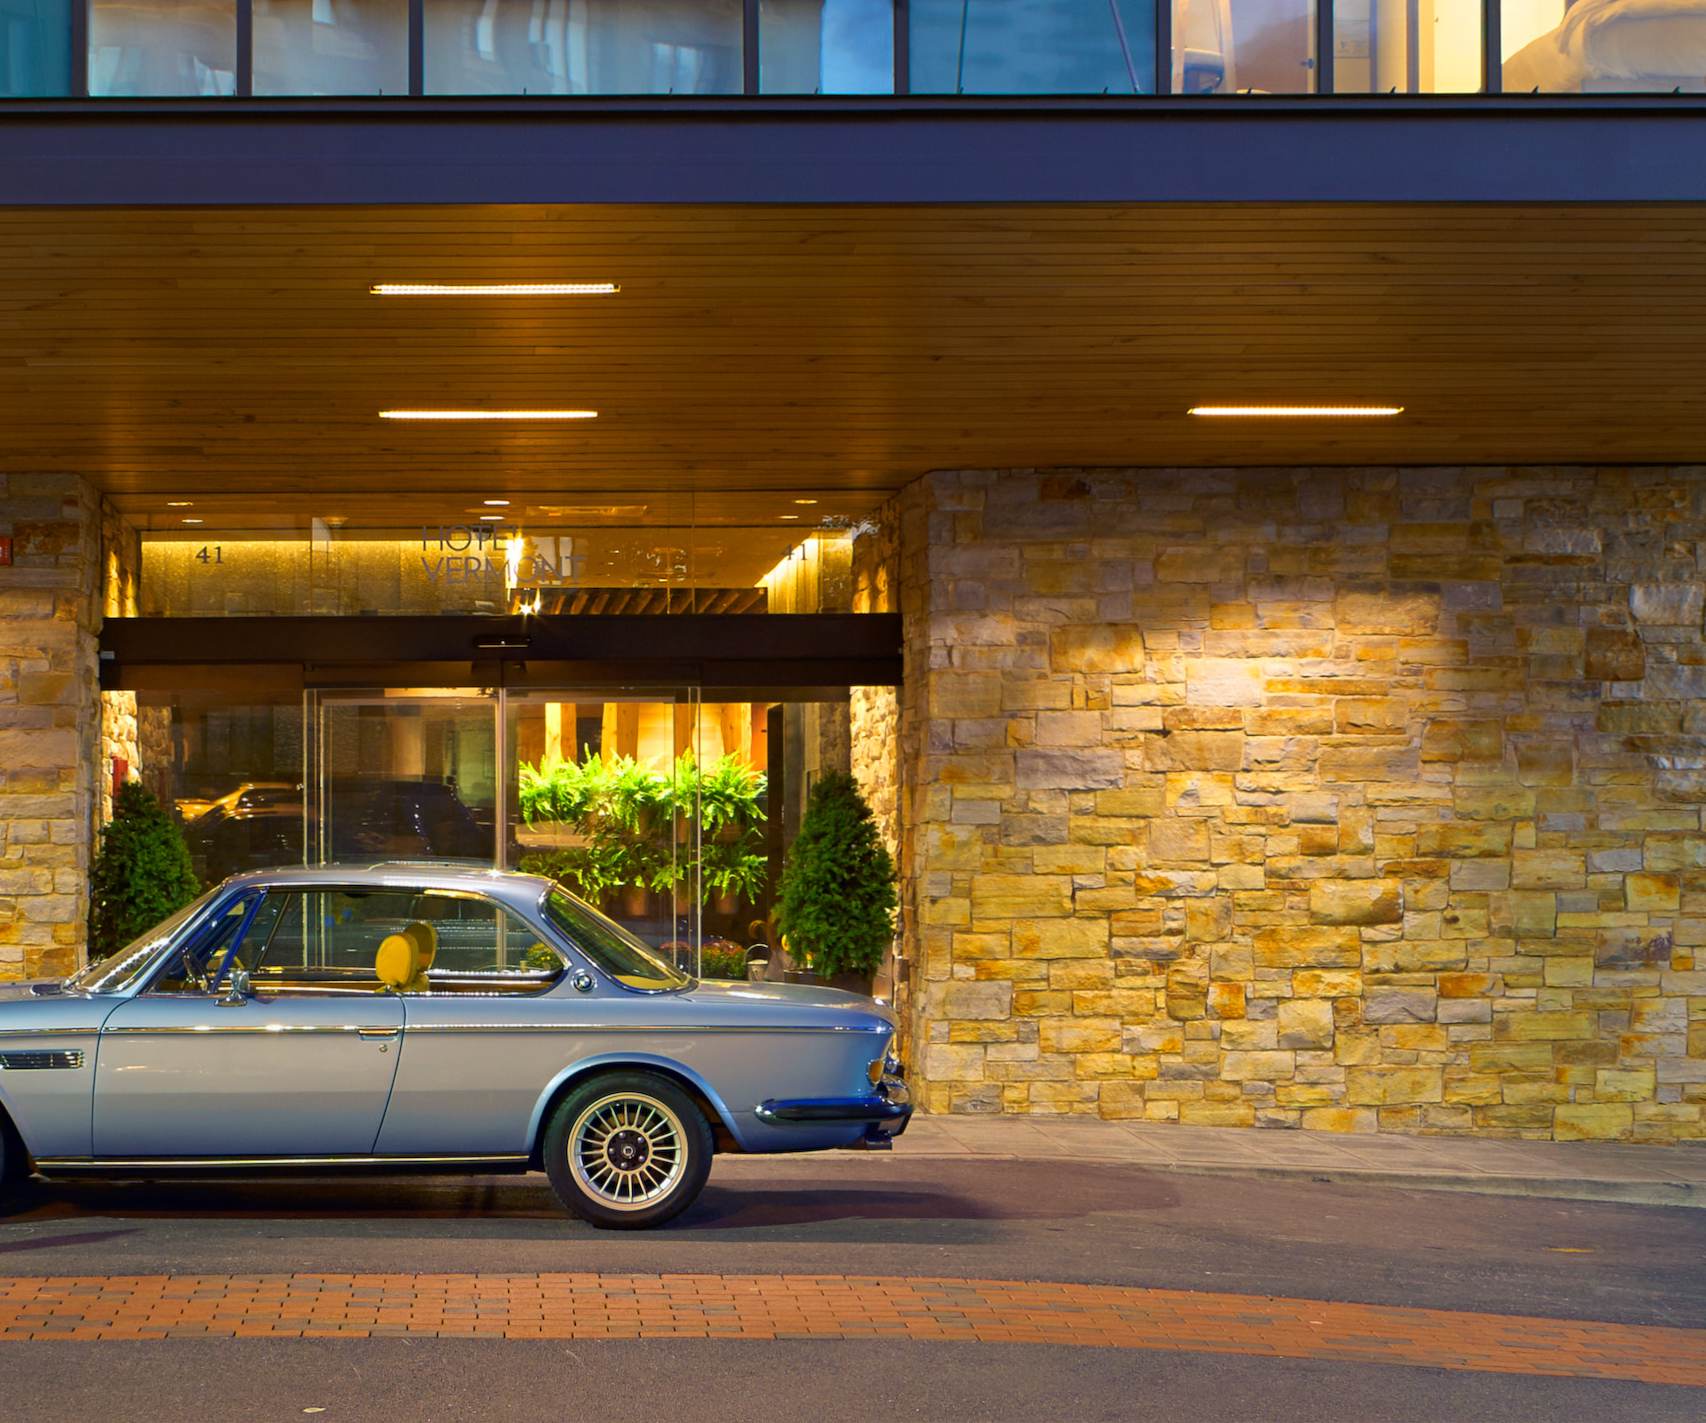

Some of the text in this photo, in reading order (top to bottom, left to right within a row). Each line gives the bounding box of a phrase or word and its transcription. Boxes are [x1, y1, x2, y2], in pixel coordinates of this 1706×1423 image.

[195, 545, 224, 564] 41
[780, 543, 808, 561] 41
[421, 553, 587, 584] VERMONT
